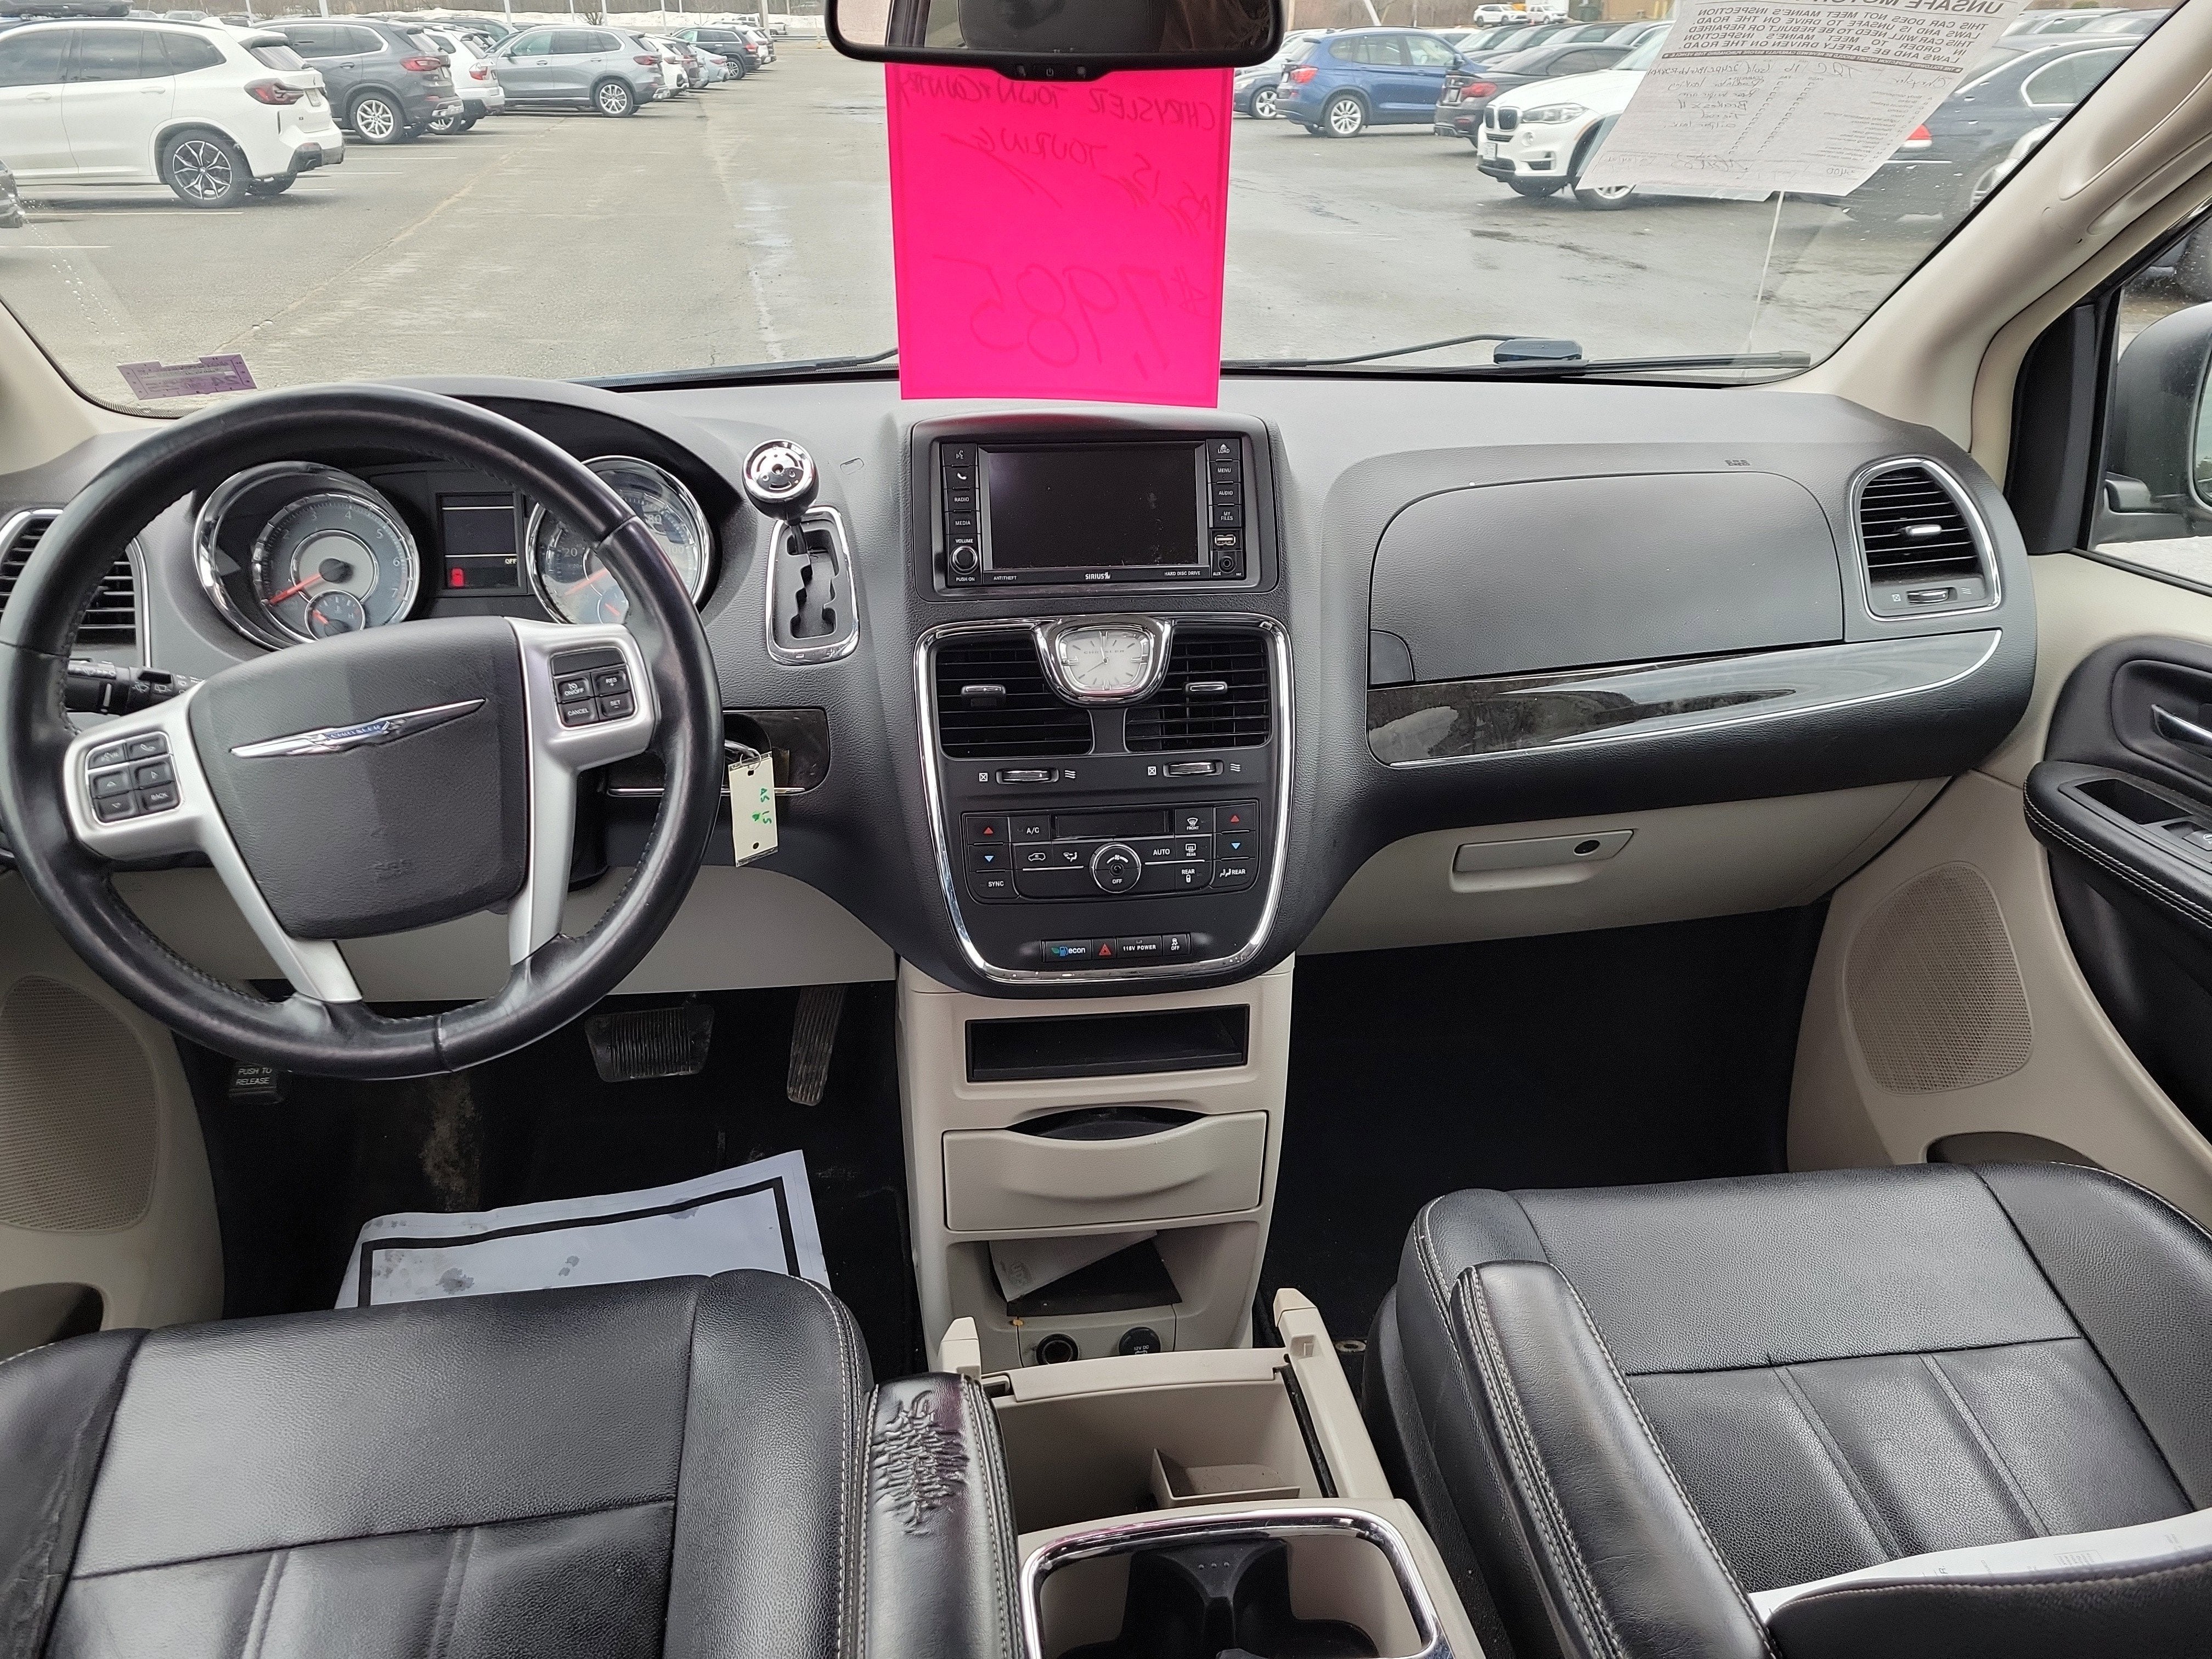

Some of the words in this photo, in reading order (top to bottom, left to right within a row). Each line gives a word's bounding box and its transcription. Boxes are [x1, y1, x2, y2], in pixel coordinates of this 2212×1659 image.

[376, 529, 383, 539] 5
[393, 556, 400, 567] 6
[1026, 826, 1040, 834] A/C
[235, 1077, 270, 1085] RELEASE
